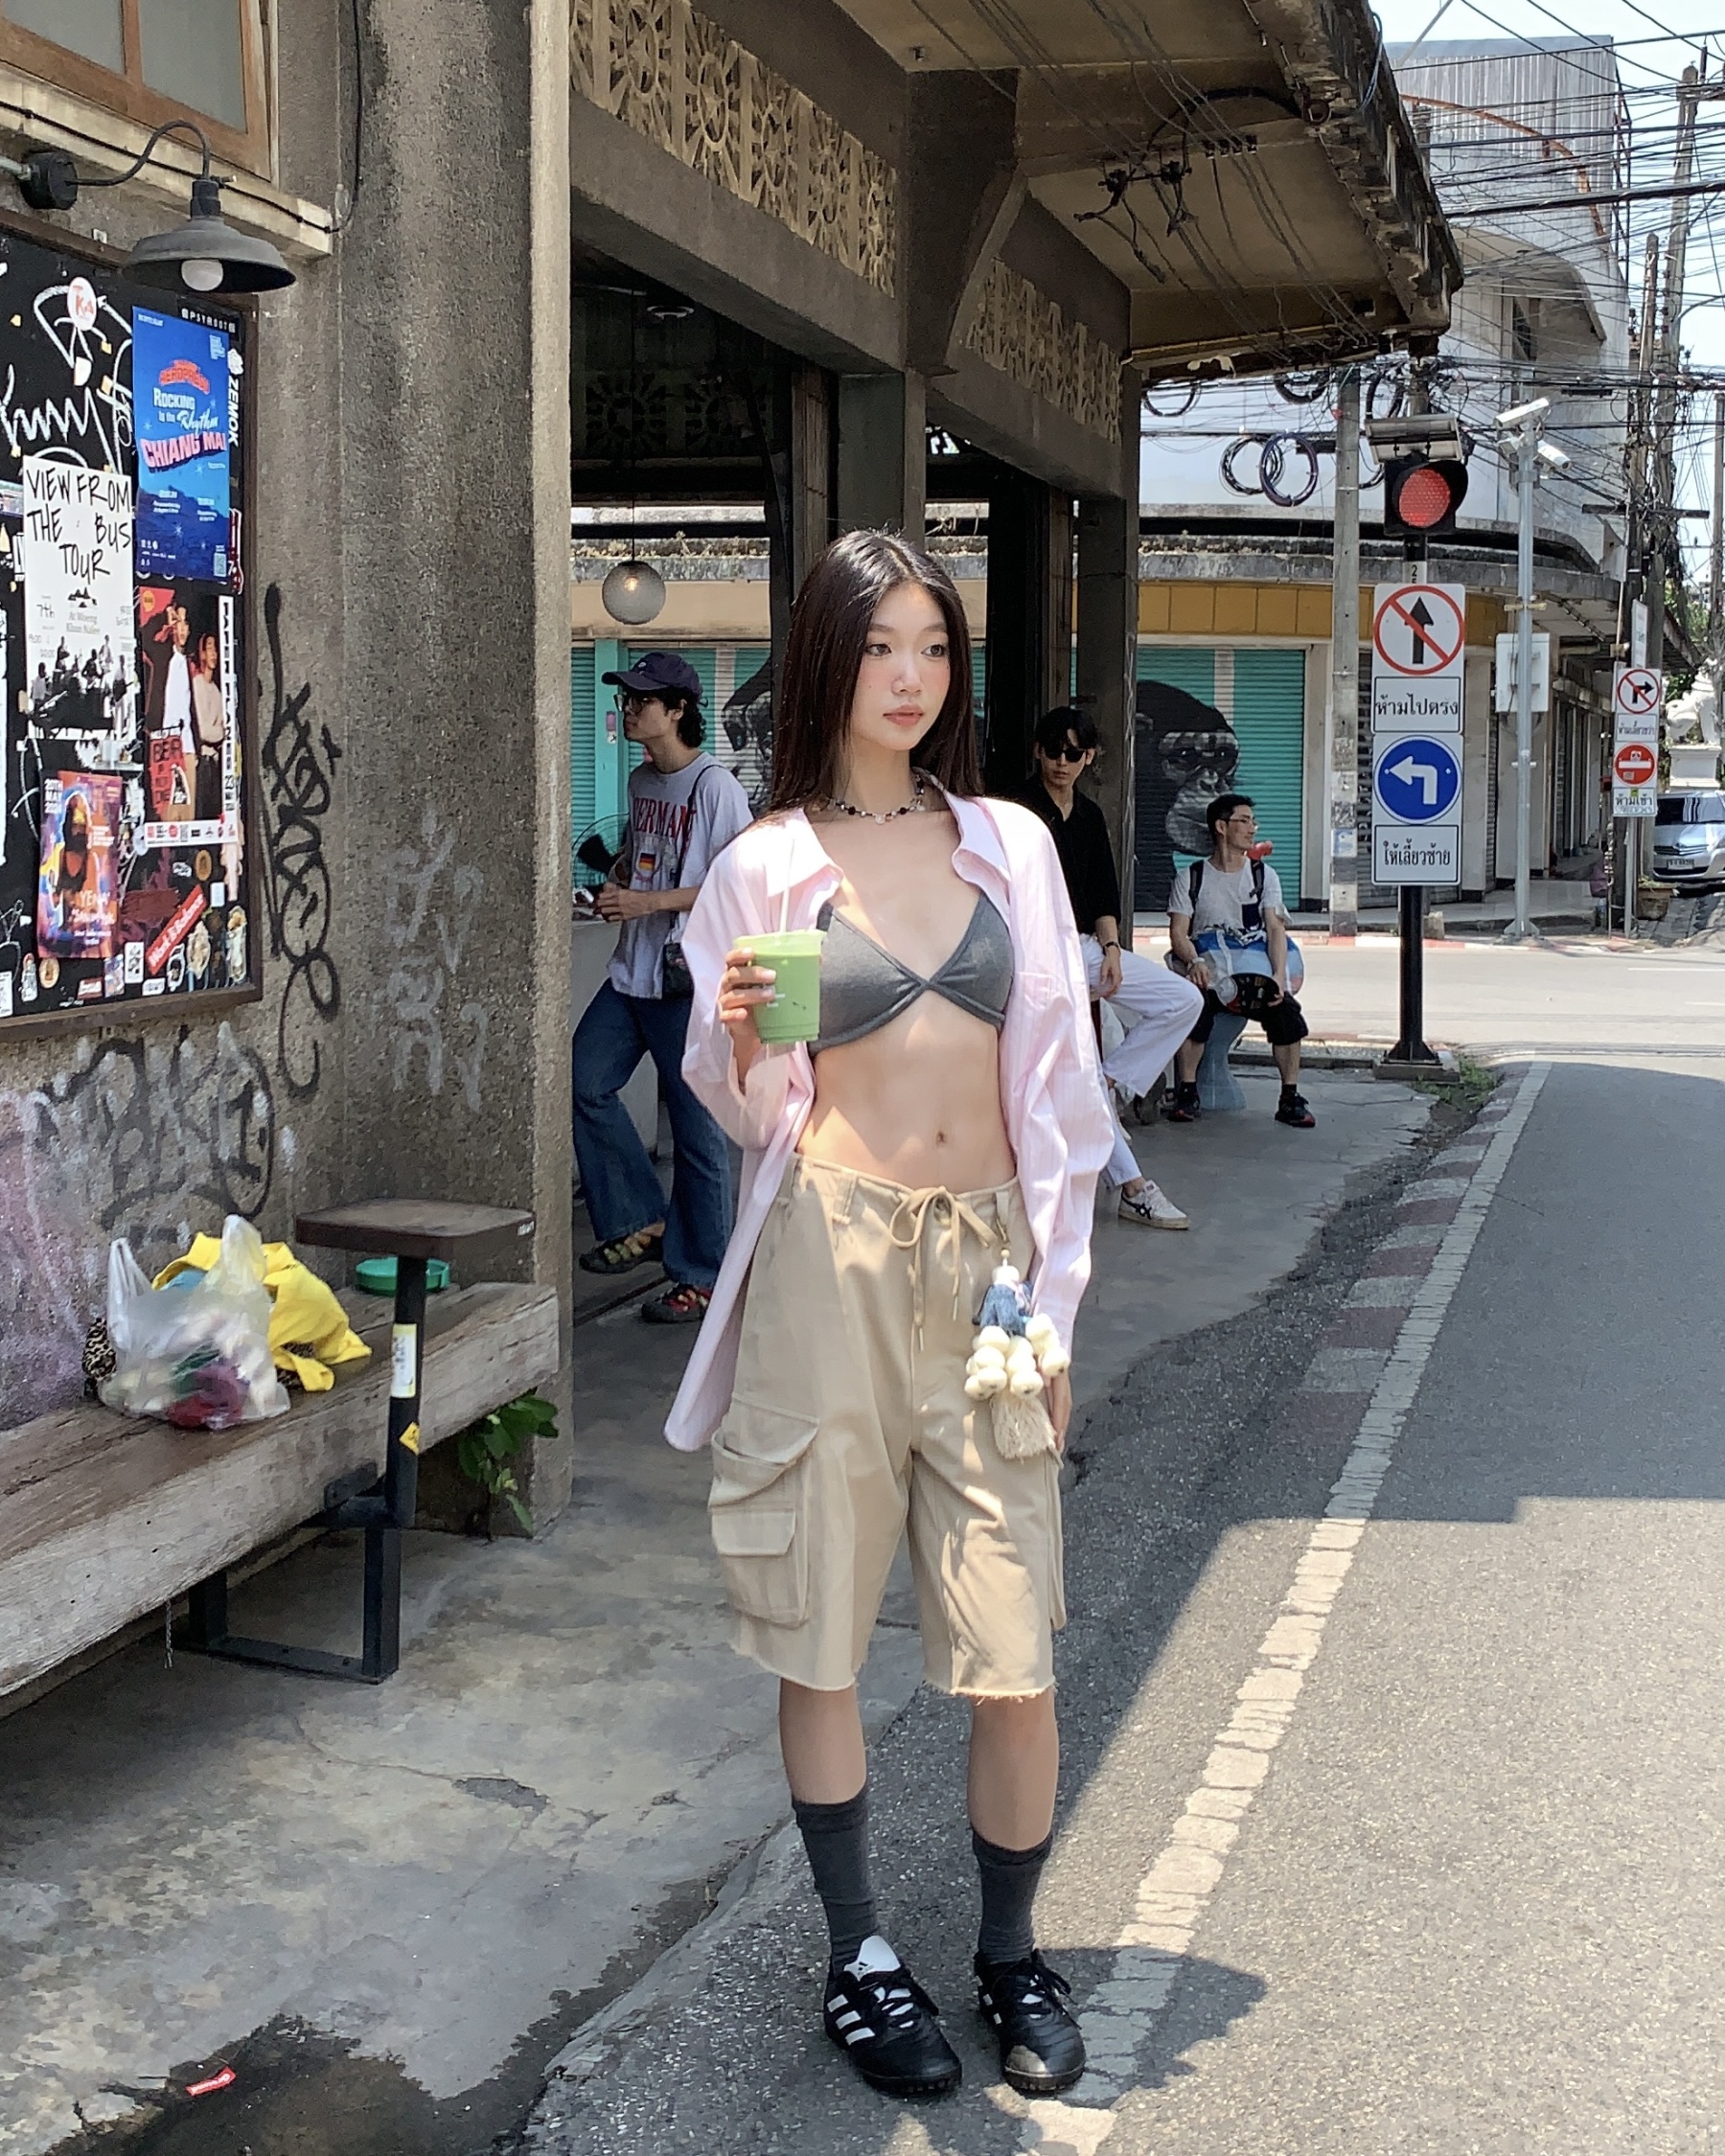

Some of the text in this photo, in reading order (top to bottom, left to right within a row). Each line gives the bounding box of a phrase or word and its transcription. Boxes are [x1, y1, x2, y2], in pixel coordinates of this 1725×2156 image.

[228, 375, 240, 448] ZEMOK
[140, 431, 227, 469] CHIANG MAI
[26, 467, 130, 514] VIEW FROM
[27, 503, 132, 553] THE BUS
[58, 542, 111, 585] TOUR
[1375, 692, 1459, 716] ห้ามไปตรง
[1615, 792, 1653, 806] ห้ามเข้า
[1382, 837, 1451, 865] ให้เลี้ยวซ้าย
